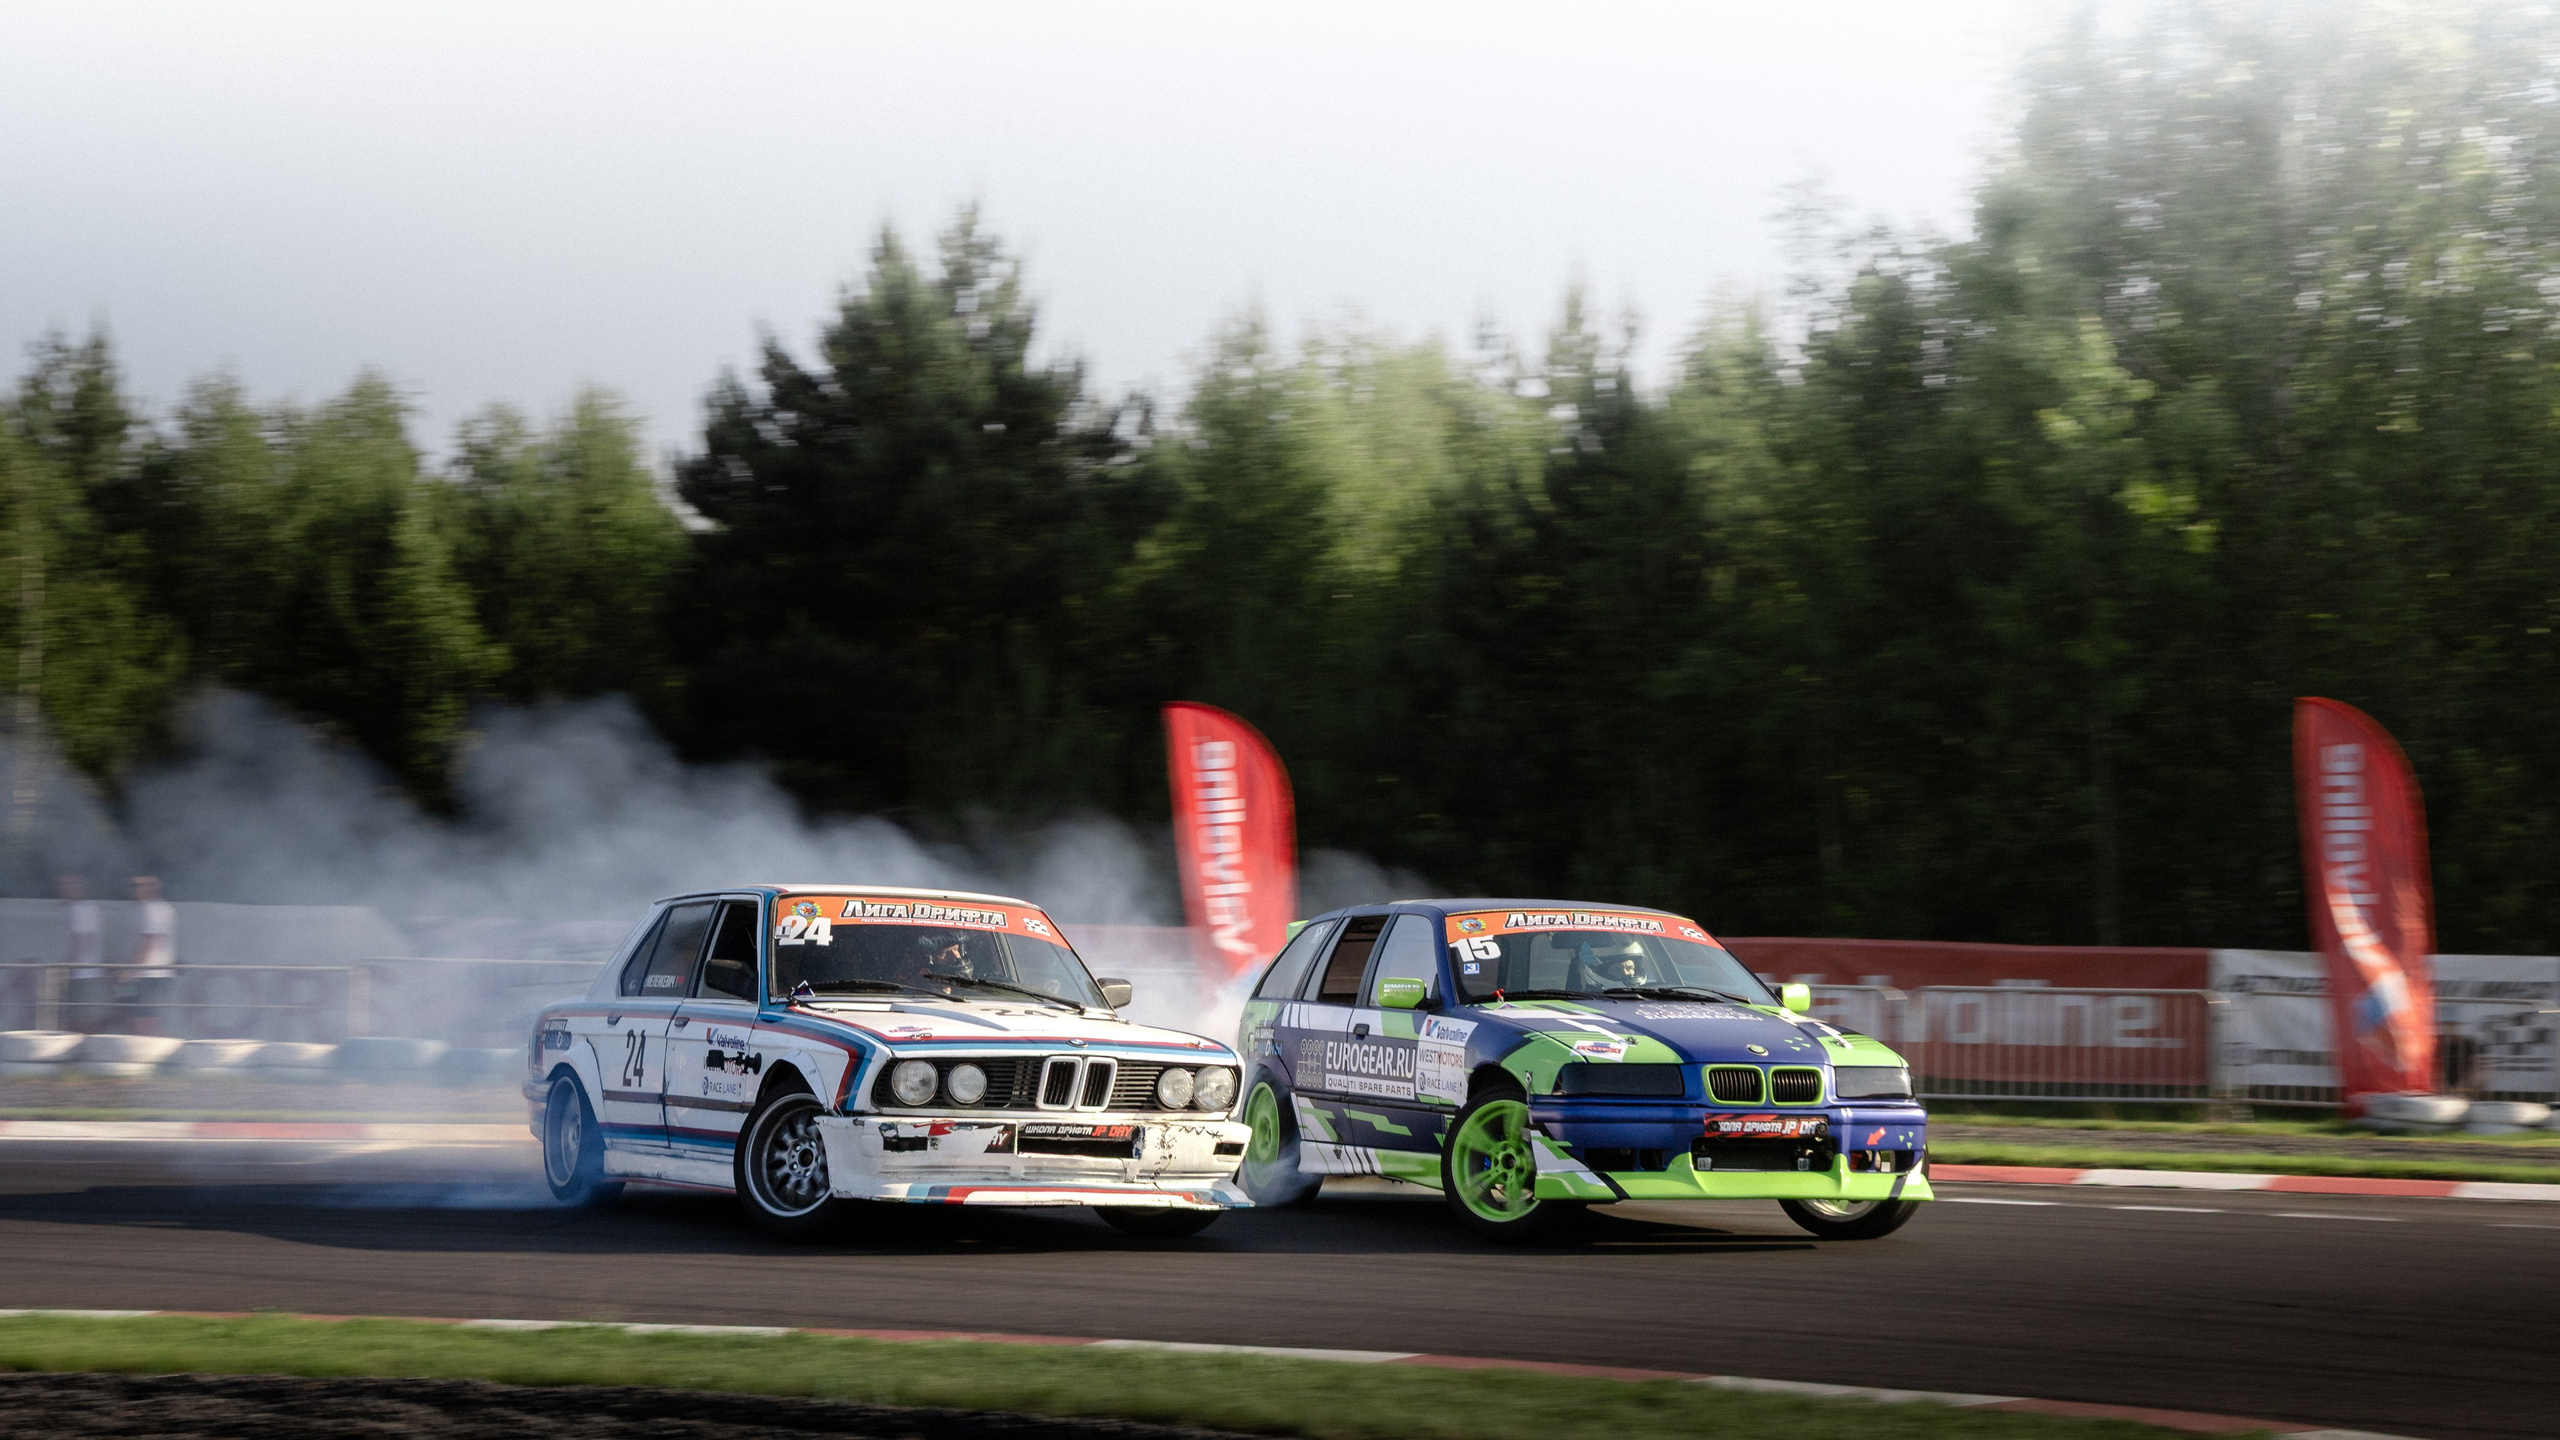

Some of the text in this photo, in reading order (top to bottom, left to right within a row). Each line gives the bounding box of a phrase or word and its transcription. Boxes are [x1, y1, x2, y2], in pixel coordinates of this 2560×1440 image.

[779, 915, 833, 946] 24
[1449, 935, 1501, 962] 15
[717, 1033, 746, 1050] Valvoline
[1437, 1025, 1468, 1042] Valvoline
[623, 1029, 646, 1088] 24
[1325, 1041, 1416, 1079] EUROGEAR.RU
[1328, 1078, 1357, 1090] QUALITI
[1359, 1081, 1383, 1093] SPARE
[1386, 1085, 1412, 1096] PARTS
[1025, 1125, 1133, 1137] ШКОЛА ДРИФТА JP DAY
[1743, 1121, 1782, 1132] ДРИФТА
[1782, 1120, 1797, 1134] JP
